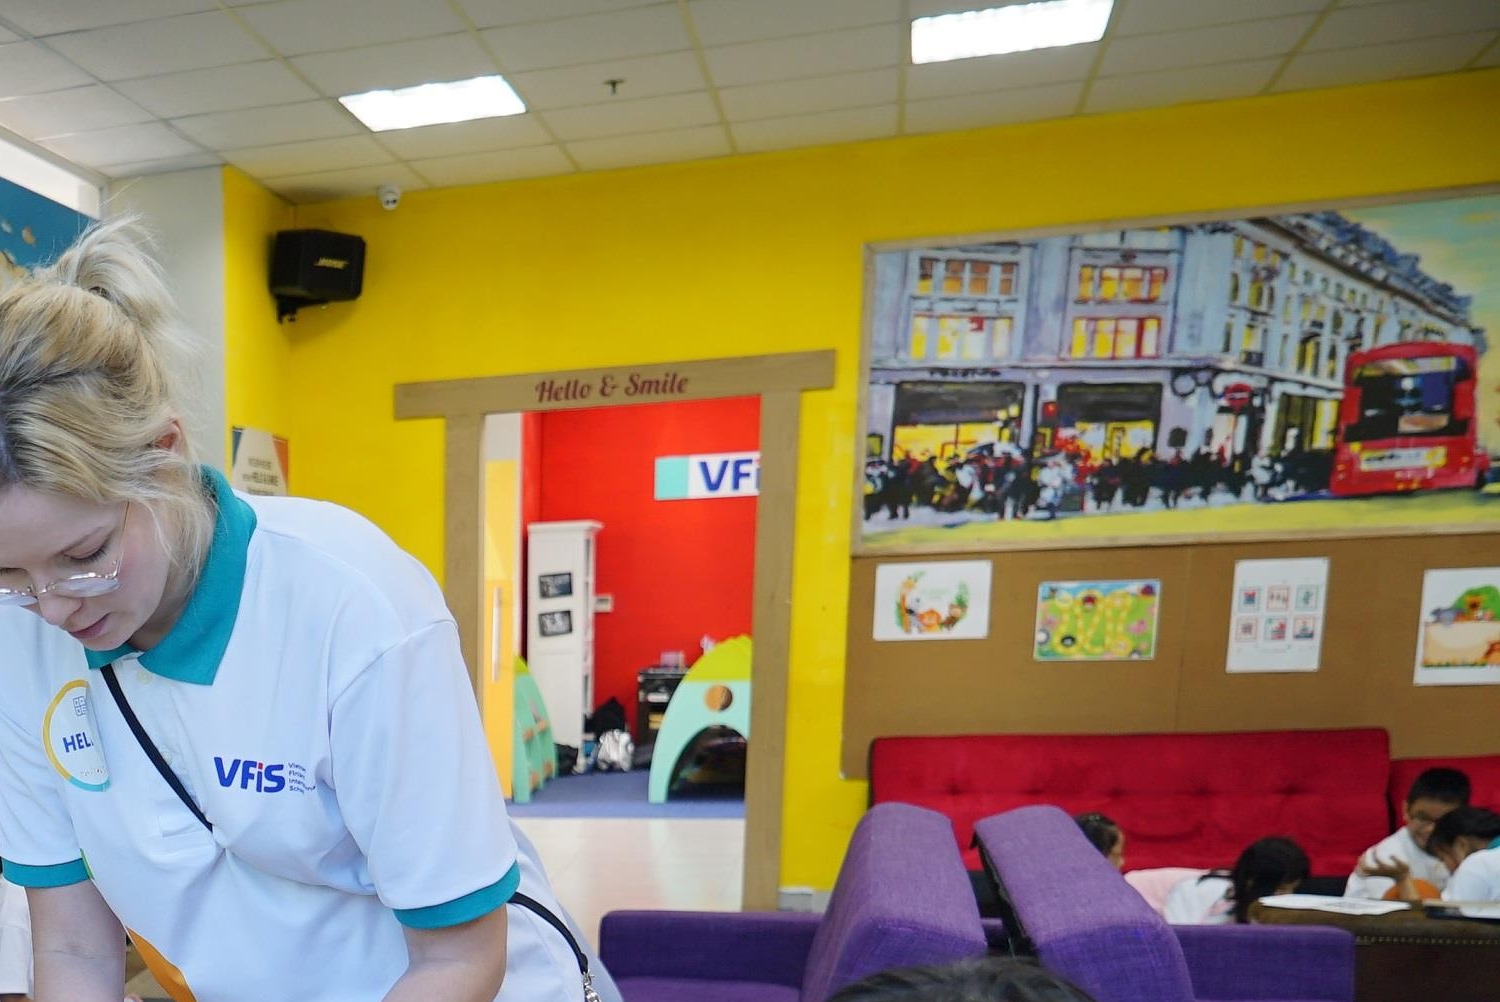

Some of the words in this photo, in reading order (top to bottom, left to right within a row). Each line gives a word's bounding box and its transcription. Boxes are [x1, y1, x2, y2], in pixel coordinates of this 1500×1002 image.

[535, 379, 591, 402] Hello
[600, 375, 618, 397] &
[625, 372, 688, 396] Smile
[62, 731, 95, 753] HEL
